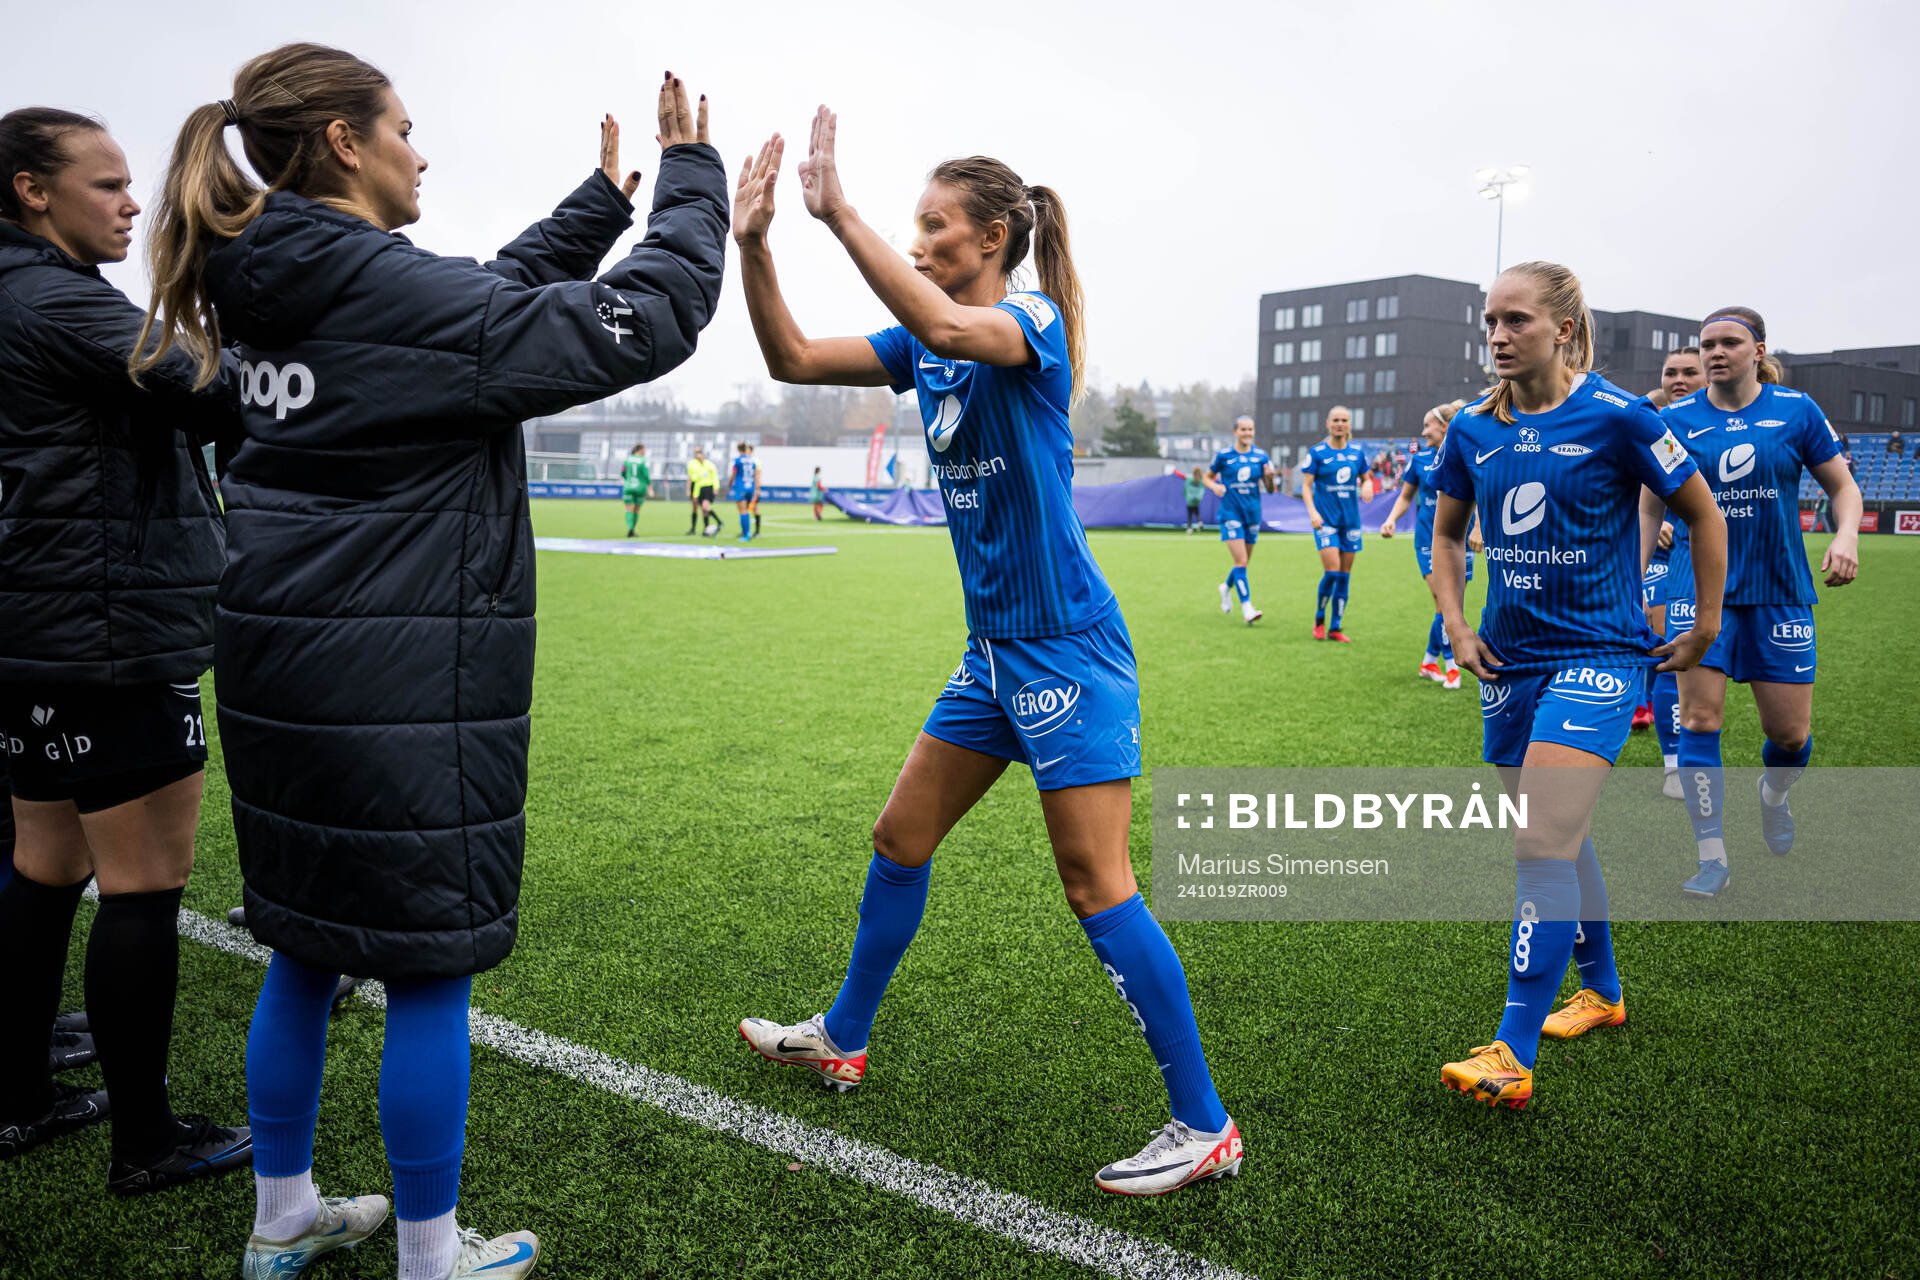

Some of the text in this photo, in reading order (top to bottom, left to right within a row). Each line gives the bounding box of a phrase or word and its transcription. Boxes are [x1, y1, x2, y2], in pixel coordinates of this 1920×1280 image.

[241, 360, 315, 420] oop
[1514, 443, 1542, 453] OBOS
[1557, 446, 1584, 454] BRANN
[944, 488, 979, 509] Vest
[1720, 505, 1754, 518] Vest
[1483, 544, 1587, 564] parebanken
[1503, 569, 1542, 590] Vest
[1772, 624, 1812, 640] LERØ
[1554, 667, 1626, 695] LERØY
[1012, 684, 1075, 717] LERØY
[1694, 771, 1713, 817] coop
[1513, 900, 1539, 973] coop
